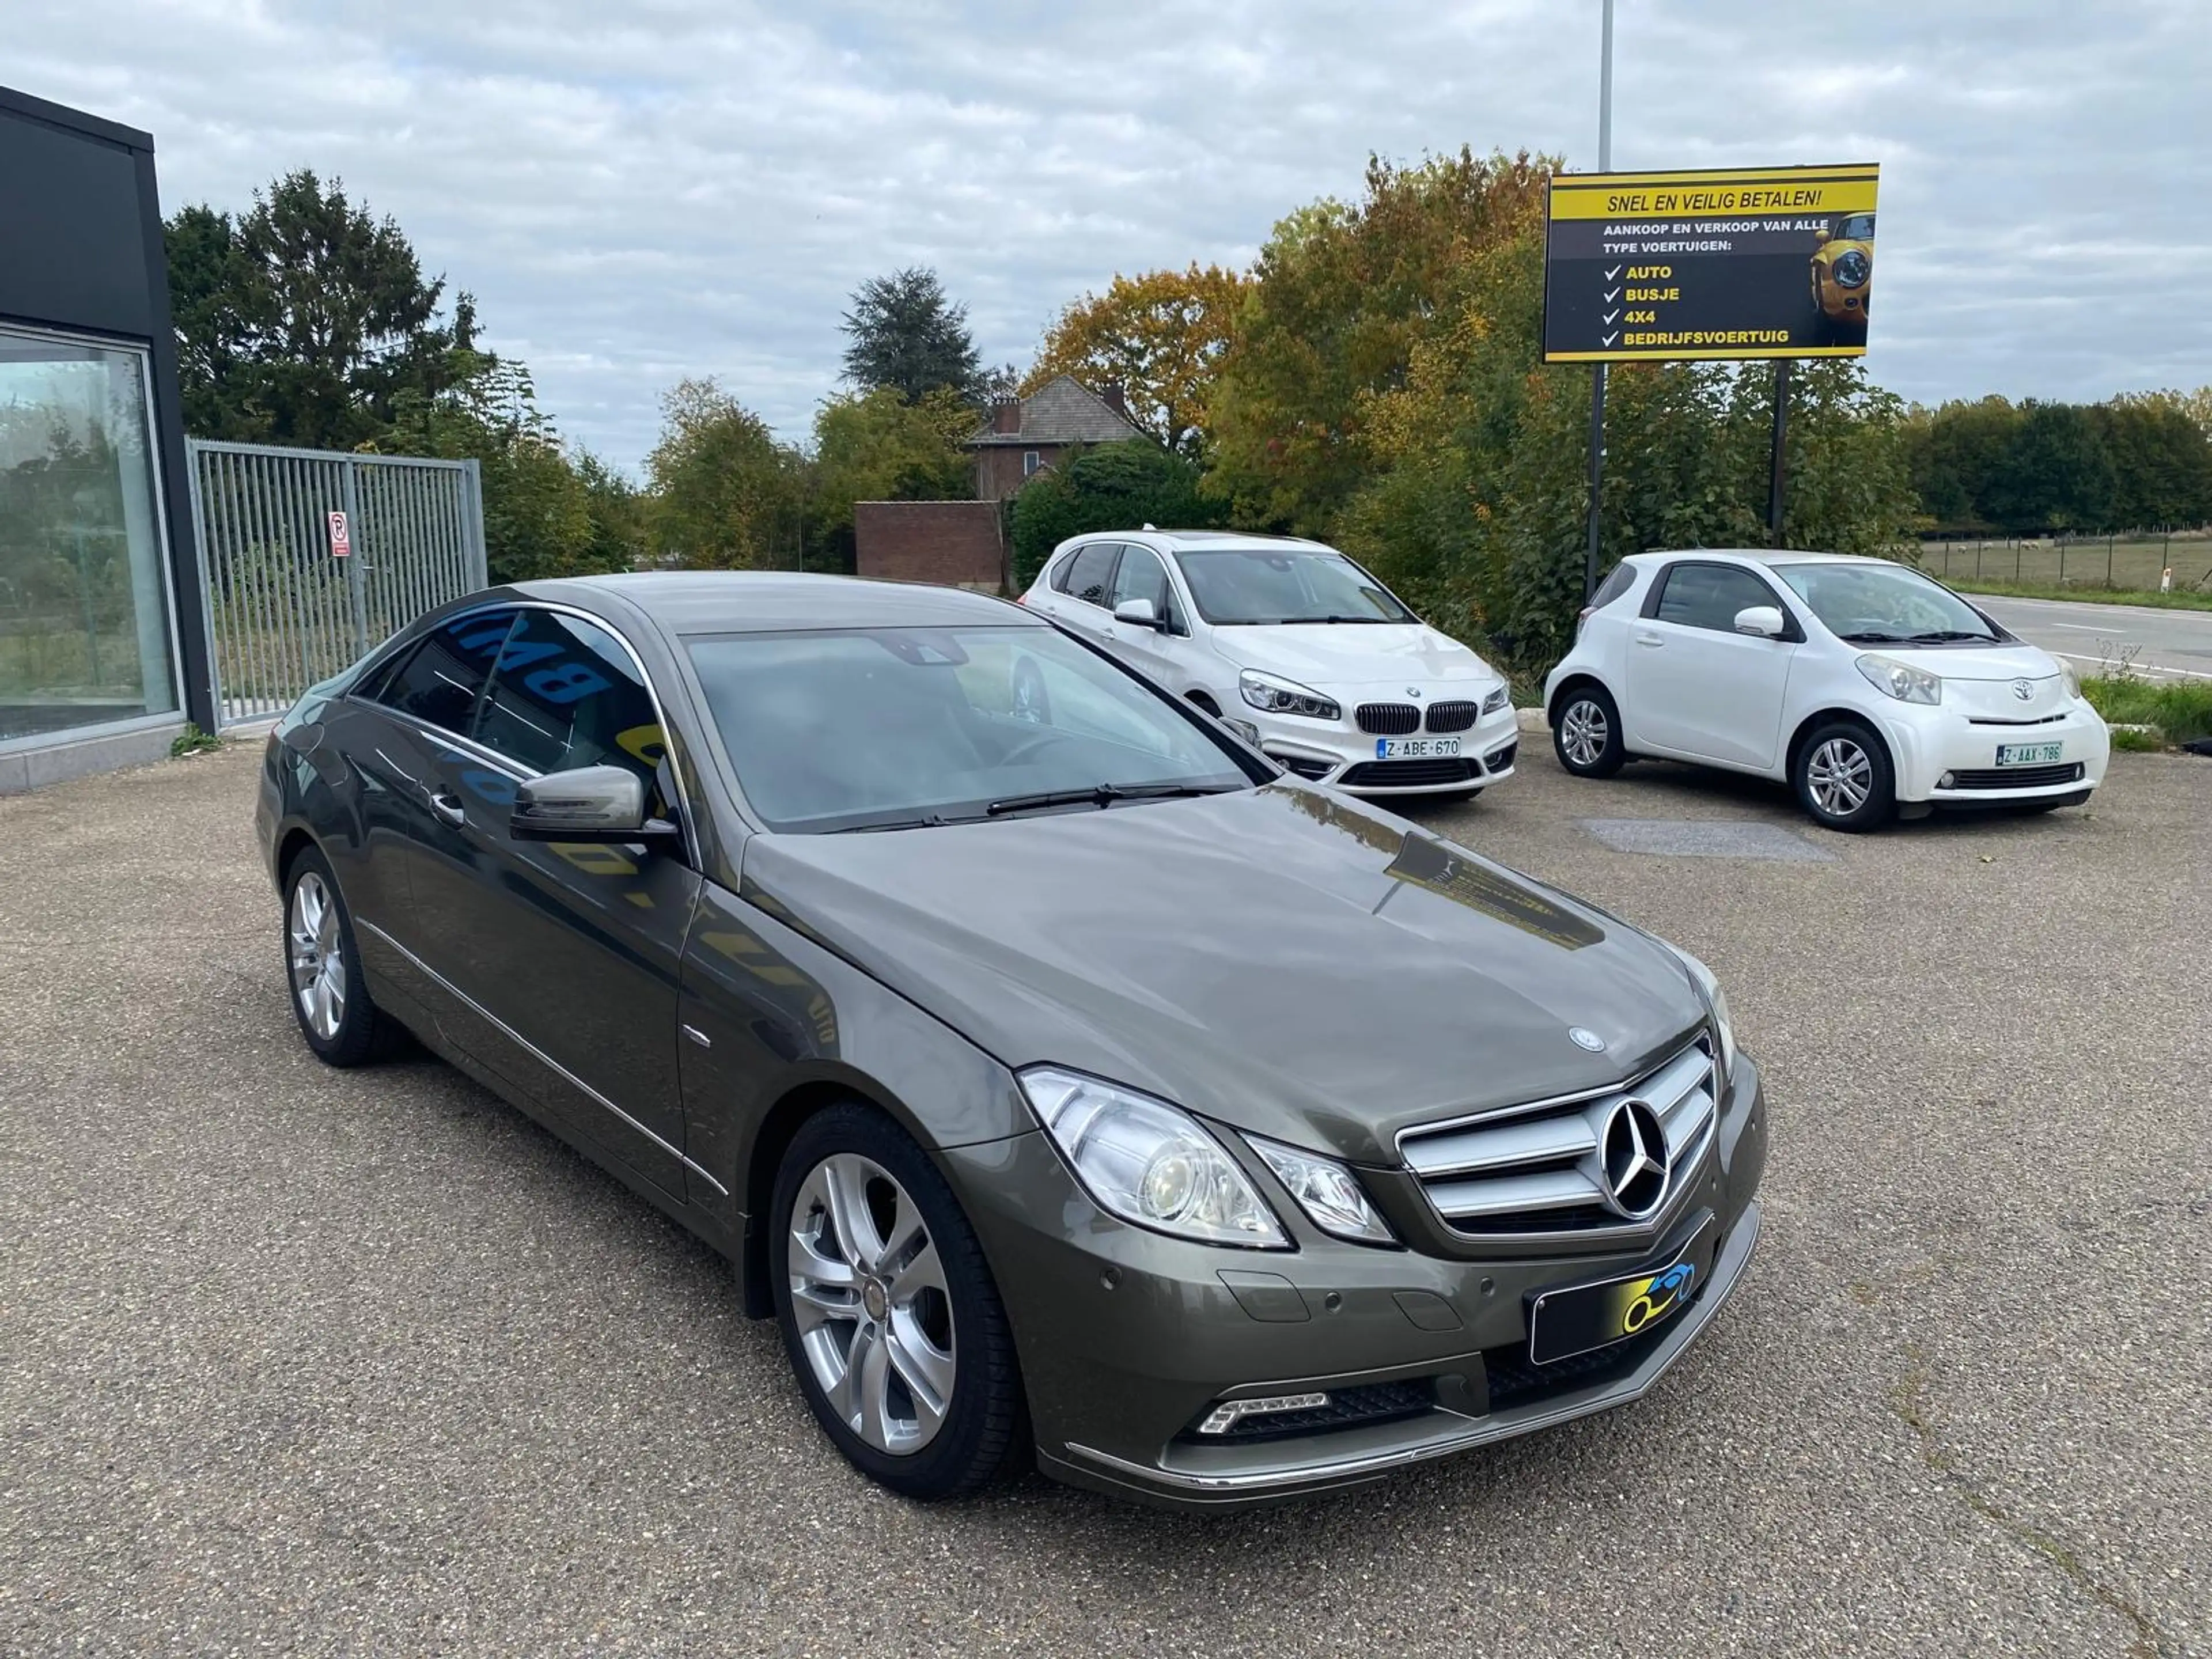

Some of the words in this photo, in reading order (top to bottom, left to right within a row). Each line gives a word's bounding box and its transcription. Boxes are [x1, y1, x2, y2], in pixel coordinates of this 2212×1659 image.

[1608, 195, 1649, 212] SNEL
[1654, 194, 1678, 211] EN
[1683, 193, 1735, 210] VEILIG
[1740, 190, 1821, 208] BETALEN!
[1604, 224, 1669, 236] AANKOOP
[1672, 224, 1691, 233] EN
[1695, 221, 1759, 234] VERKOOP
[1763, 221, 1791, 232] VAN
[1794, 219, 1829, 230] ALLE
[1604, 243, 1638, 253] TYPE
[1641, 240, 1732, 252] VOERTUIGEN:
[1626, 267, 1672, 279] AUTO
[1626, 288, 1680, 301] BUSJE
[1624, 310, 1656, 323] 4X4
[1623, 331, 1789, 345] BEDRIJFSVOERTUIG
